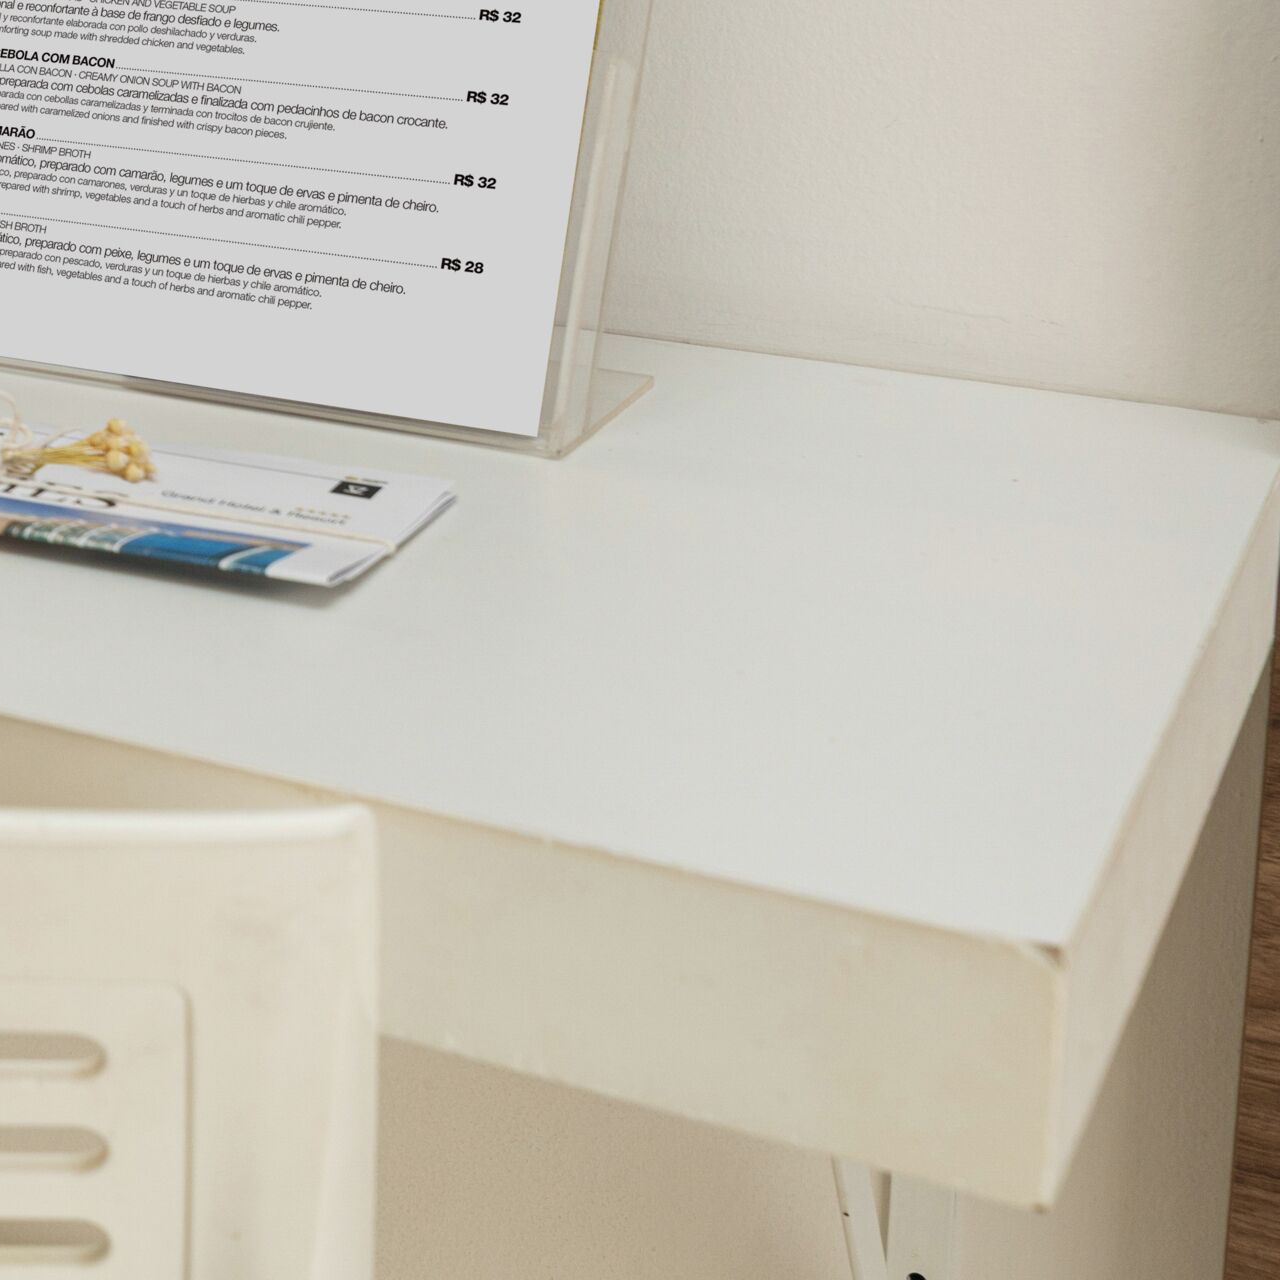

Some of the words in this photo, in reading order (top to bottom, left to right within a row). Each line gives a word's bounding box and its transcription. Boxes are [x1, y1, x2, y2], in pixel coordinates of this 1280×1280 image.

[478, 8, 500, 23] R$
[502, 10, 522, 24] 32
[41, 51, 71, 65] COM
[71, 54, 116, 69] BACON
[466, 90, 487, 105] R$
[489, 92, 510, 106] 32
[453, 173, 475, 188] R$
[477, 176, 497, 190] 32
[440, 257, 462, 273] R$
[463, 260, 484, 275] 28
